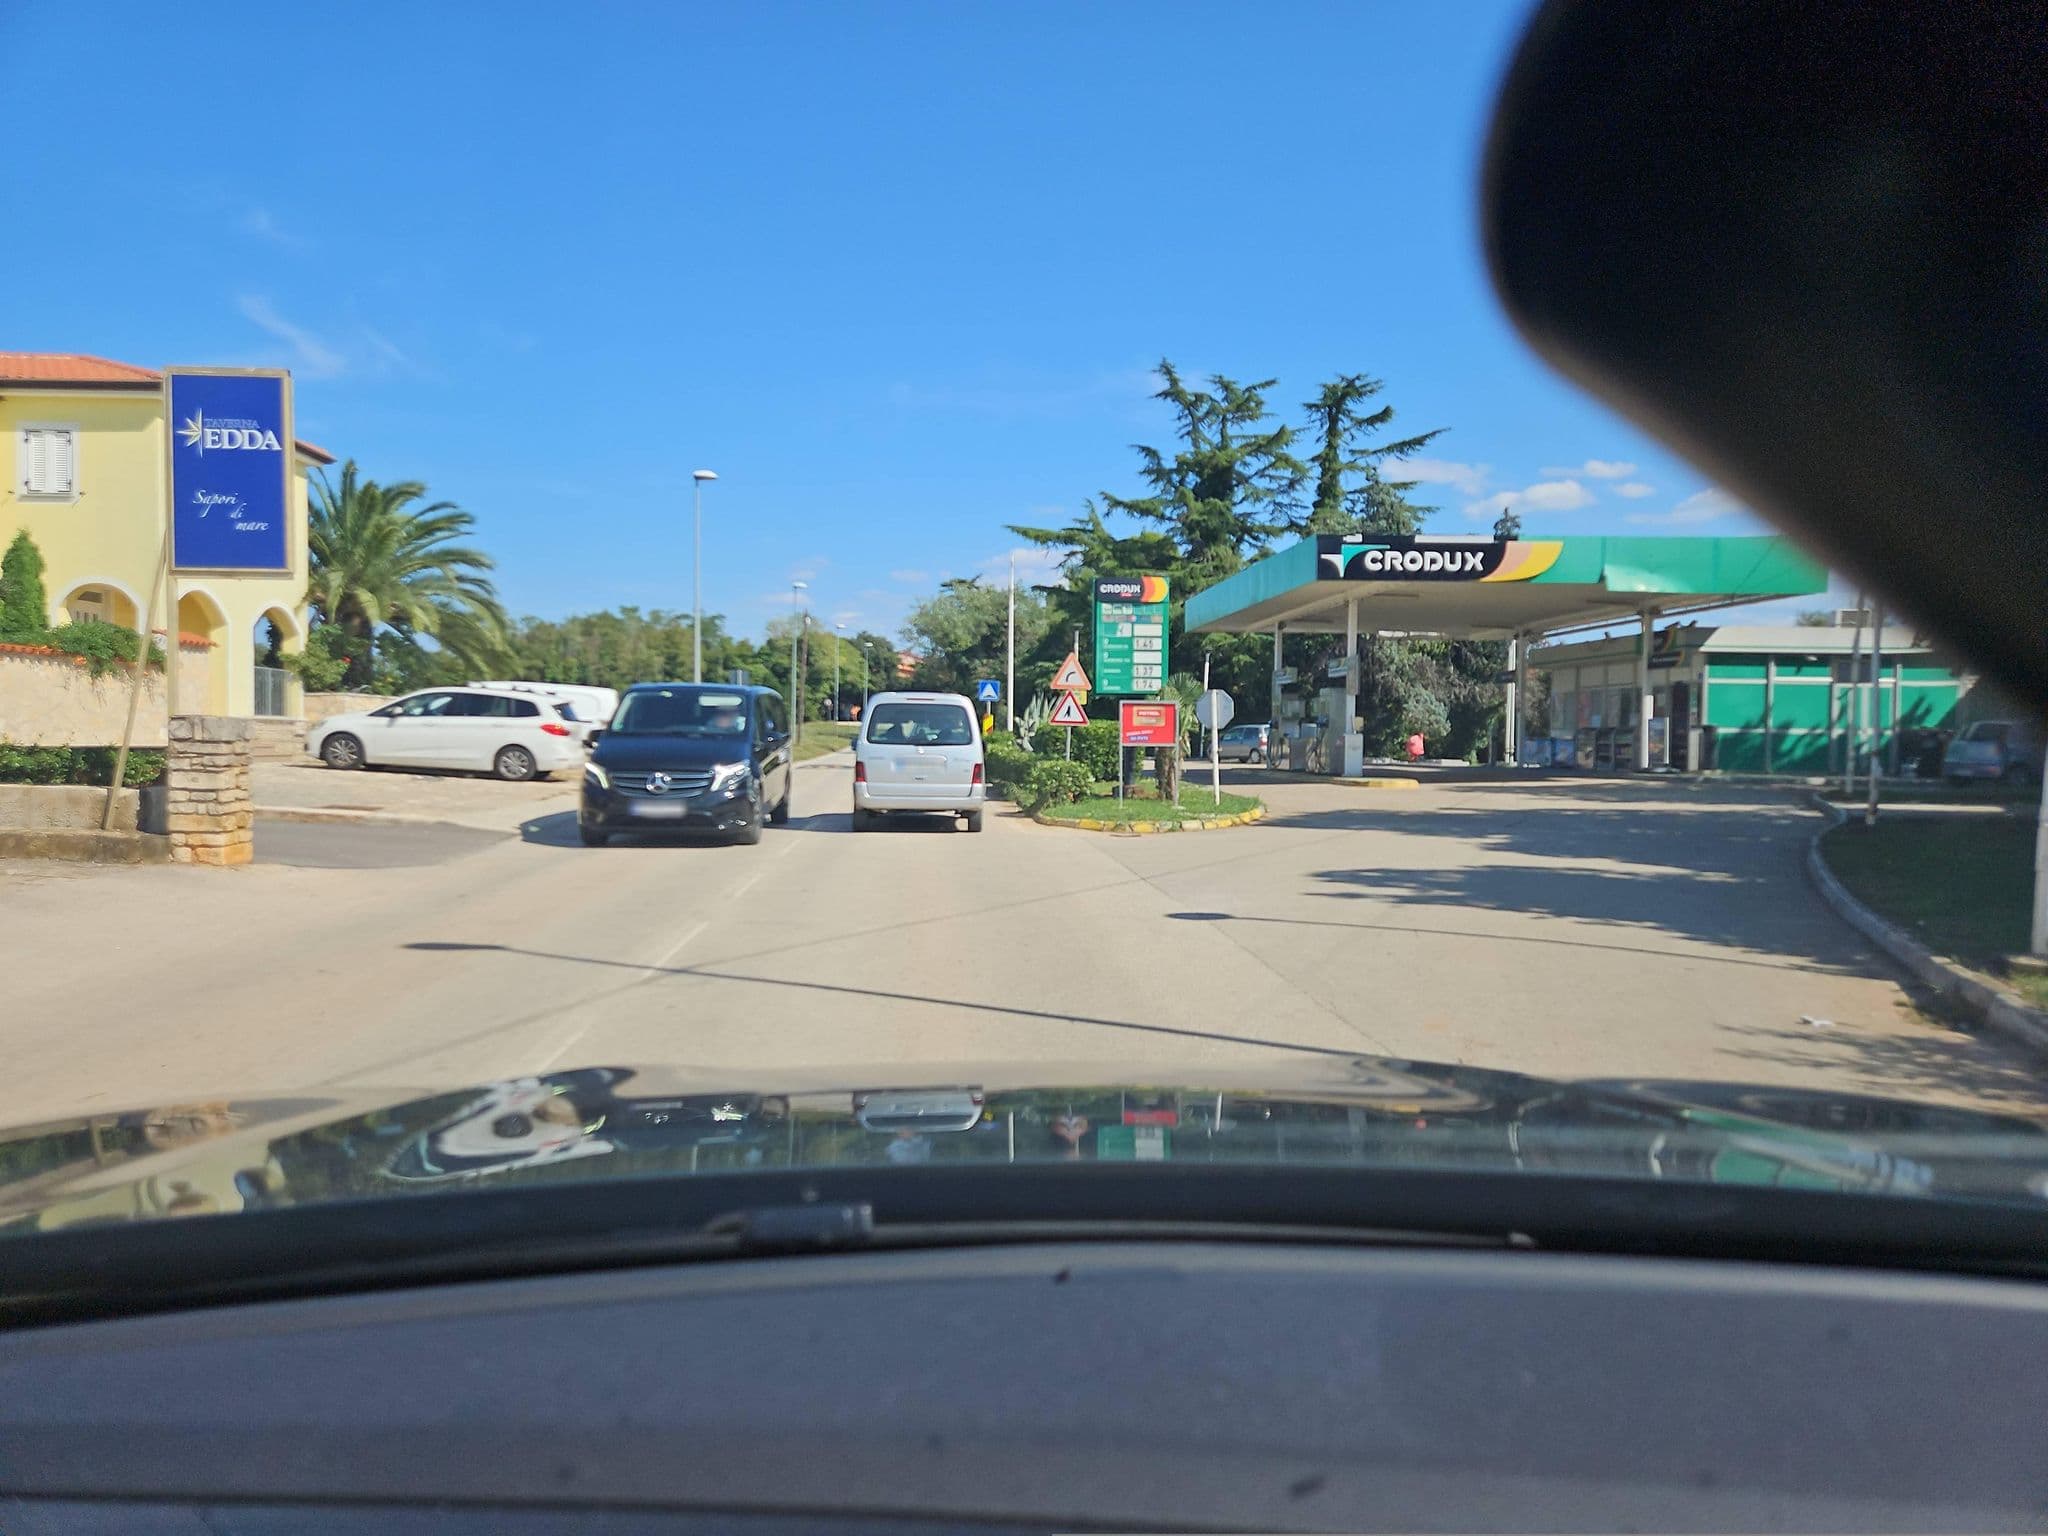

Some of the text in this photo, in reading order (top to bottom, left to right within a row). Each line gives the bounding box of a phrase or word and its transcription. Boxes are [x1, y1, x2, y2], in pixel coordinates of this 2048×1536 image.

[203, 418, 260, 429] TAVERNA
[203, 428, 282, 450] EDDA
[192, 489, 238, 518] Sapori
[229, 502, 247, 519] di
[235, 521, 269, 531] mare
[1364, 550, 1484, 572] CRODUX
[1100, 583, 1141, 594] CRODUX
